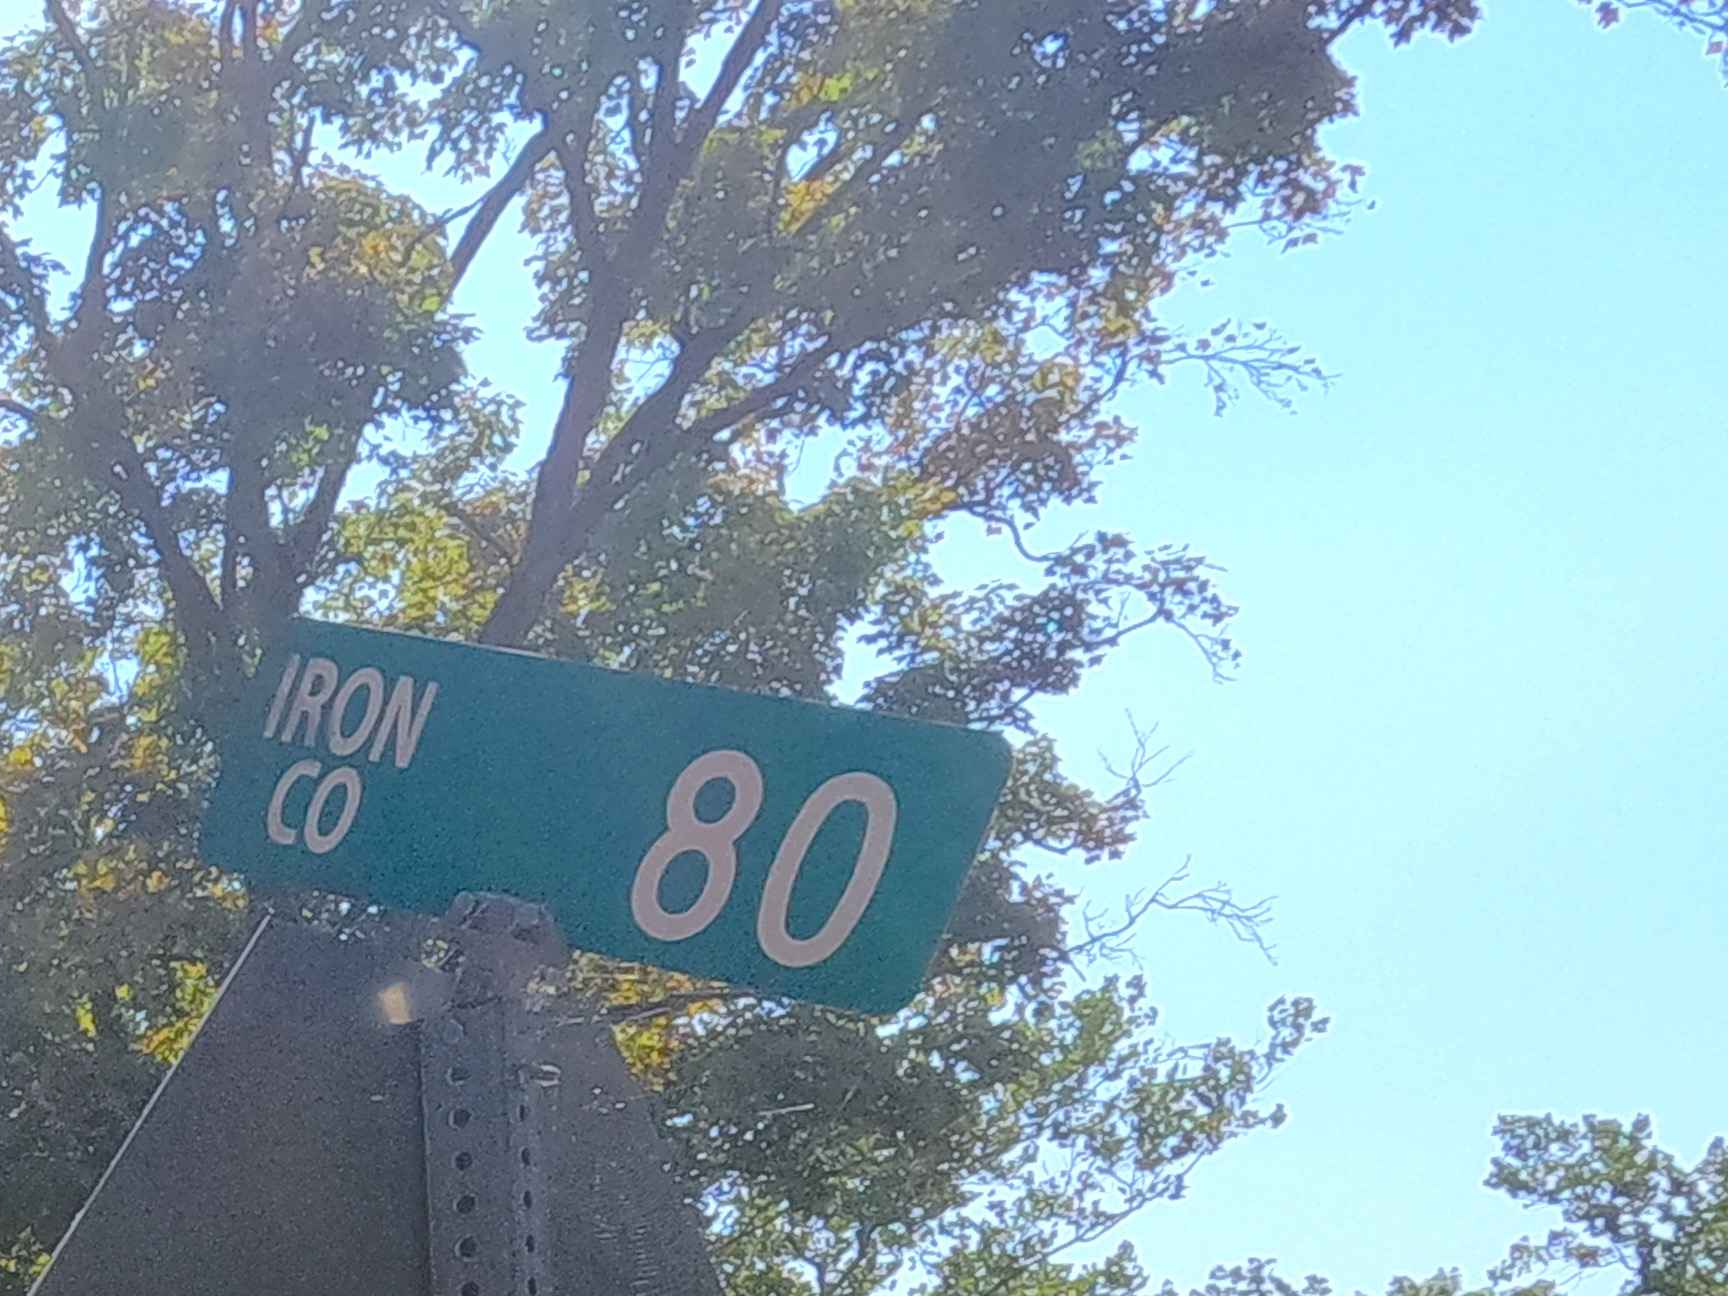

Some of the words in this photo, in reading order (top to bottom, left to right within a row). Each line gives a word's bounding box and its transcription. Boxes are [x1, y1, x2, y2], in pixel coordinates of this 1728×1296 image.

[263, 654, 439, 769] IRON
[265, 759, 363, 855] CO
[630, 749, 899, 968] 80
